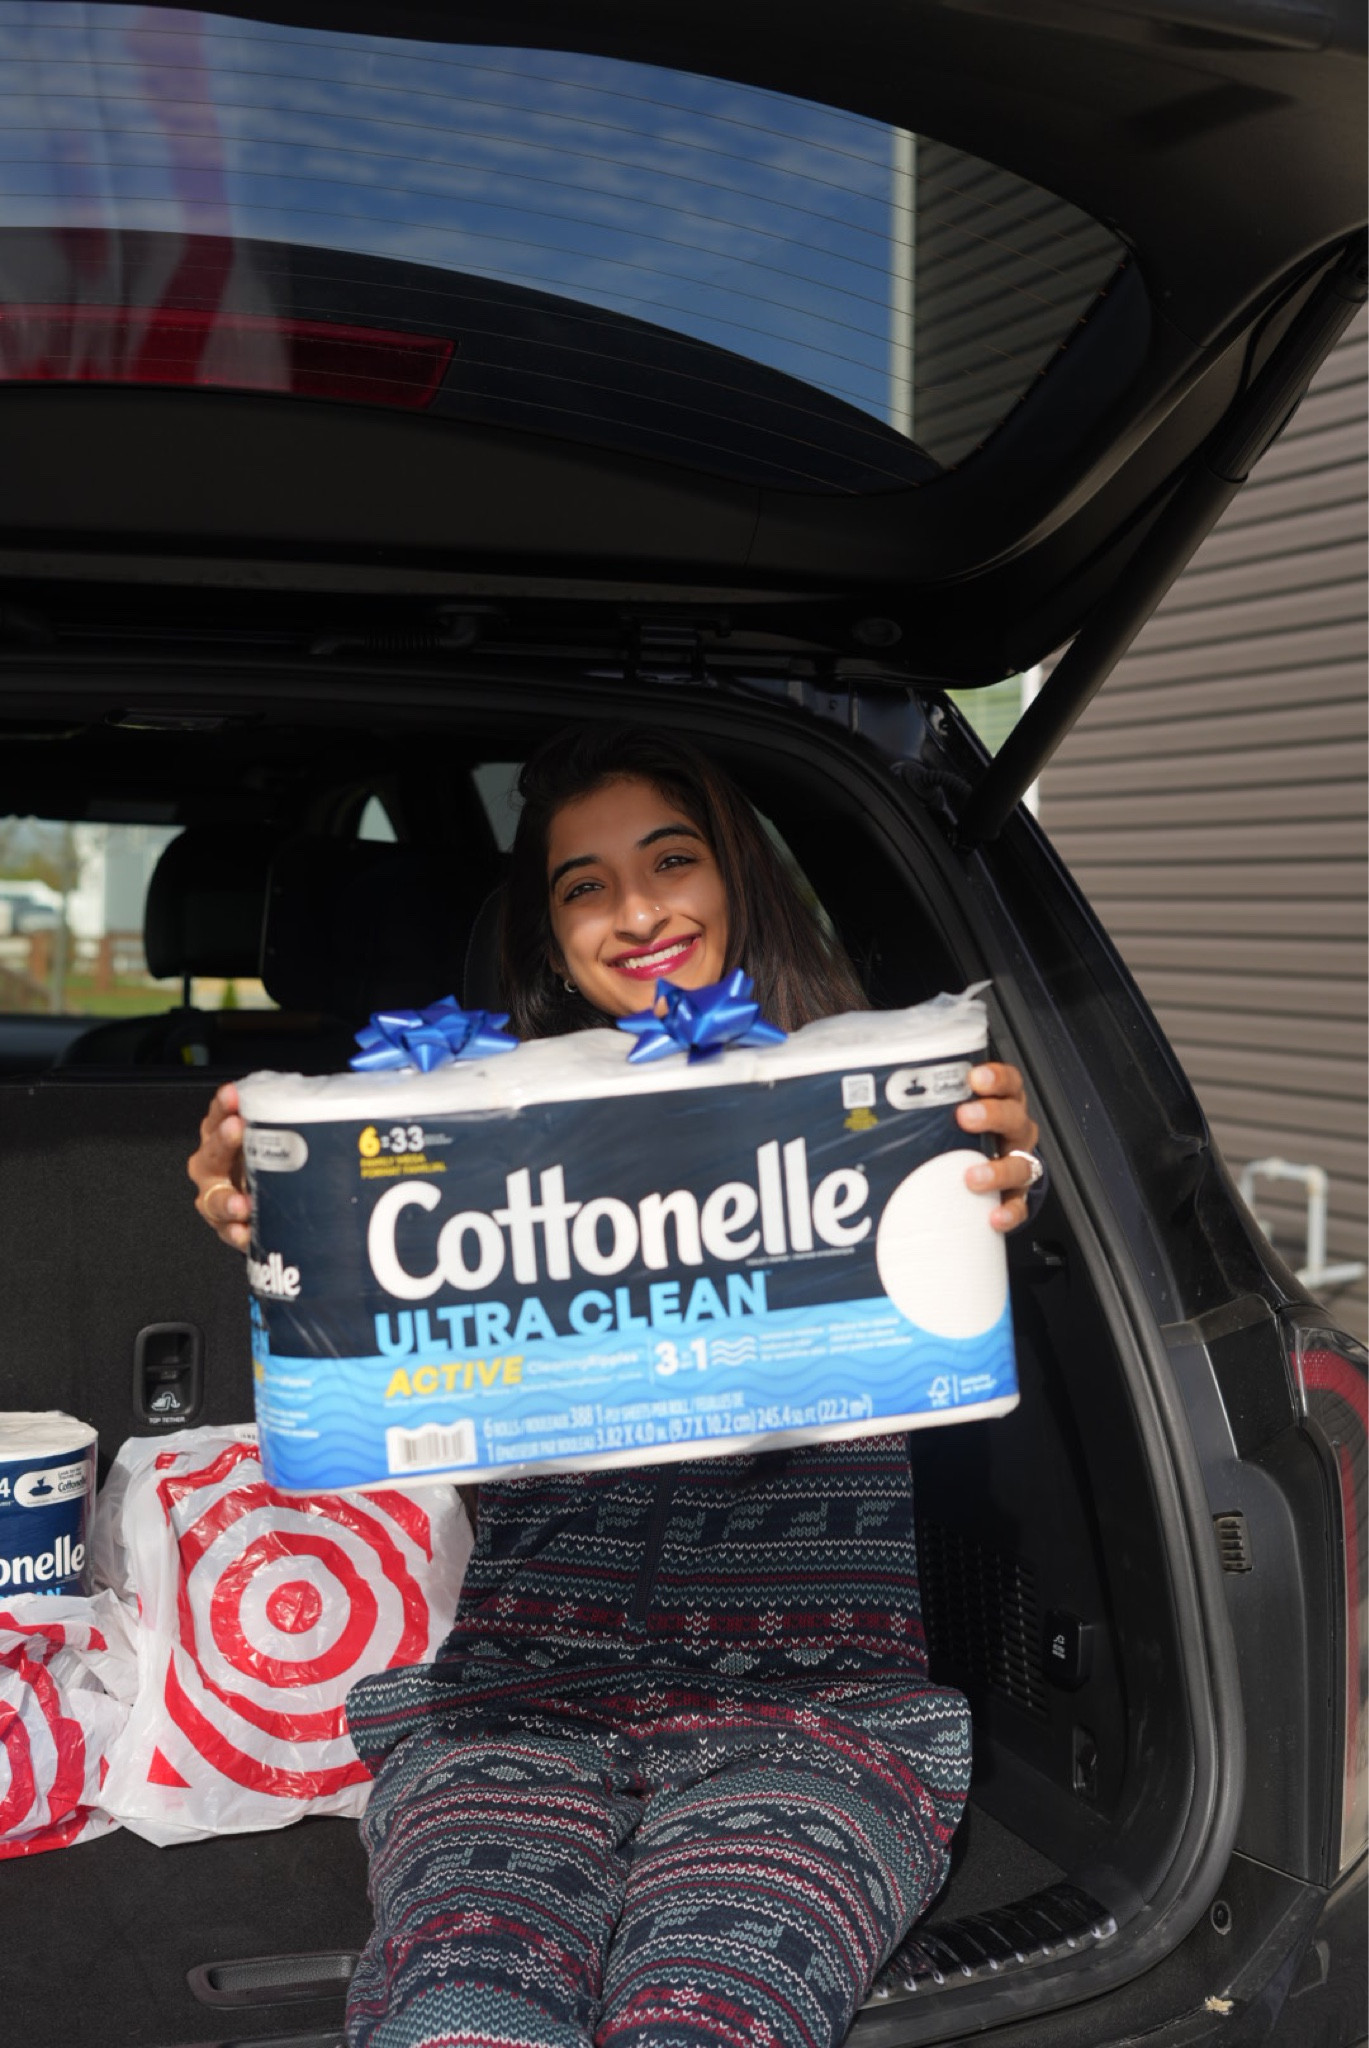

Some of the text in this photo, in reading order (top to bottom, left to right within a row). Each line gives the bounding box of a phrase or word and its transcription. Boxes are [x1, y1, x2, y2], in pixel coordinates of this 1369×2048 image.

[368, 1137, 872, 1300] Cottonelle
[374, 1297, 557, 1359] ULTRA
[568, 1270, 768, 1337] CLEAN
[384, 1356, 525, 1399] ACTIVE
